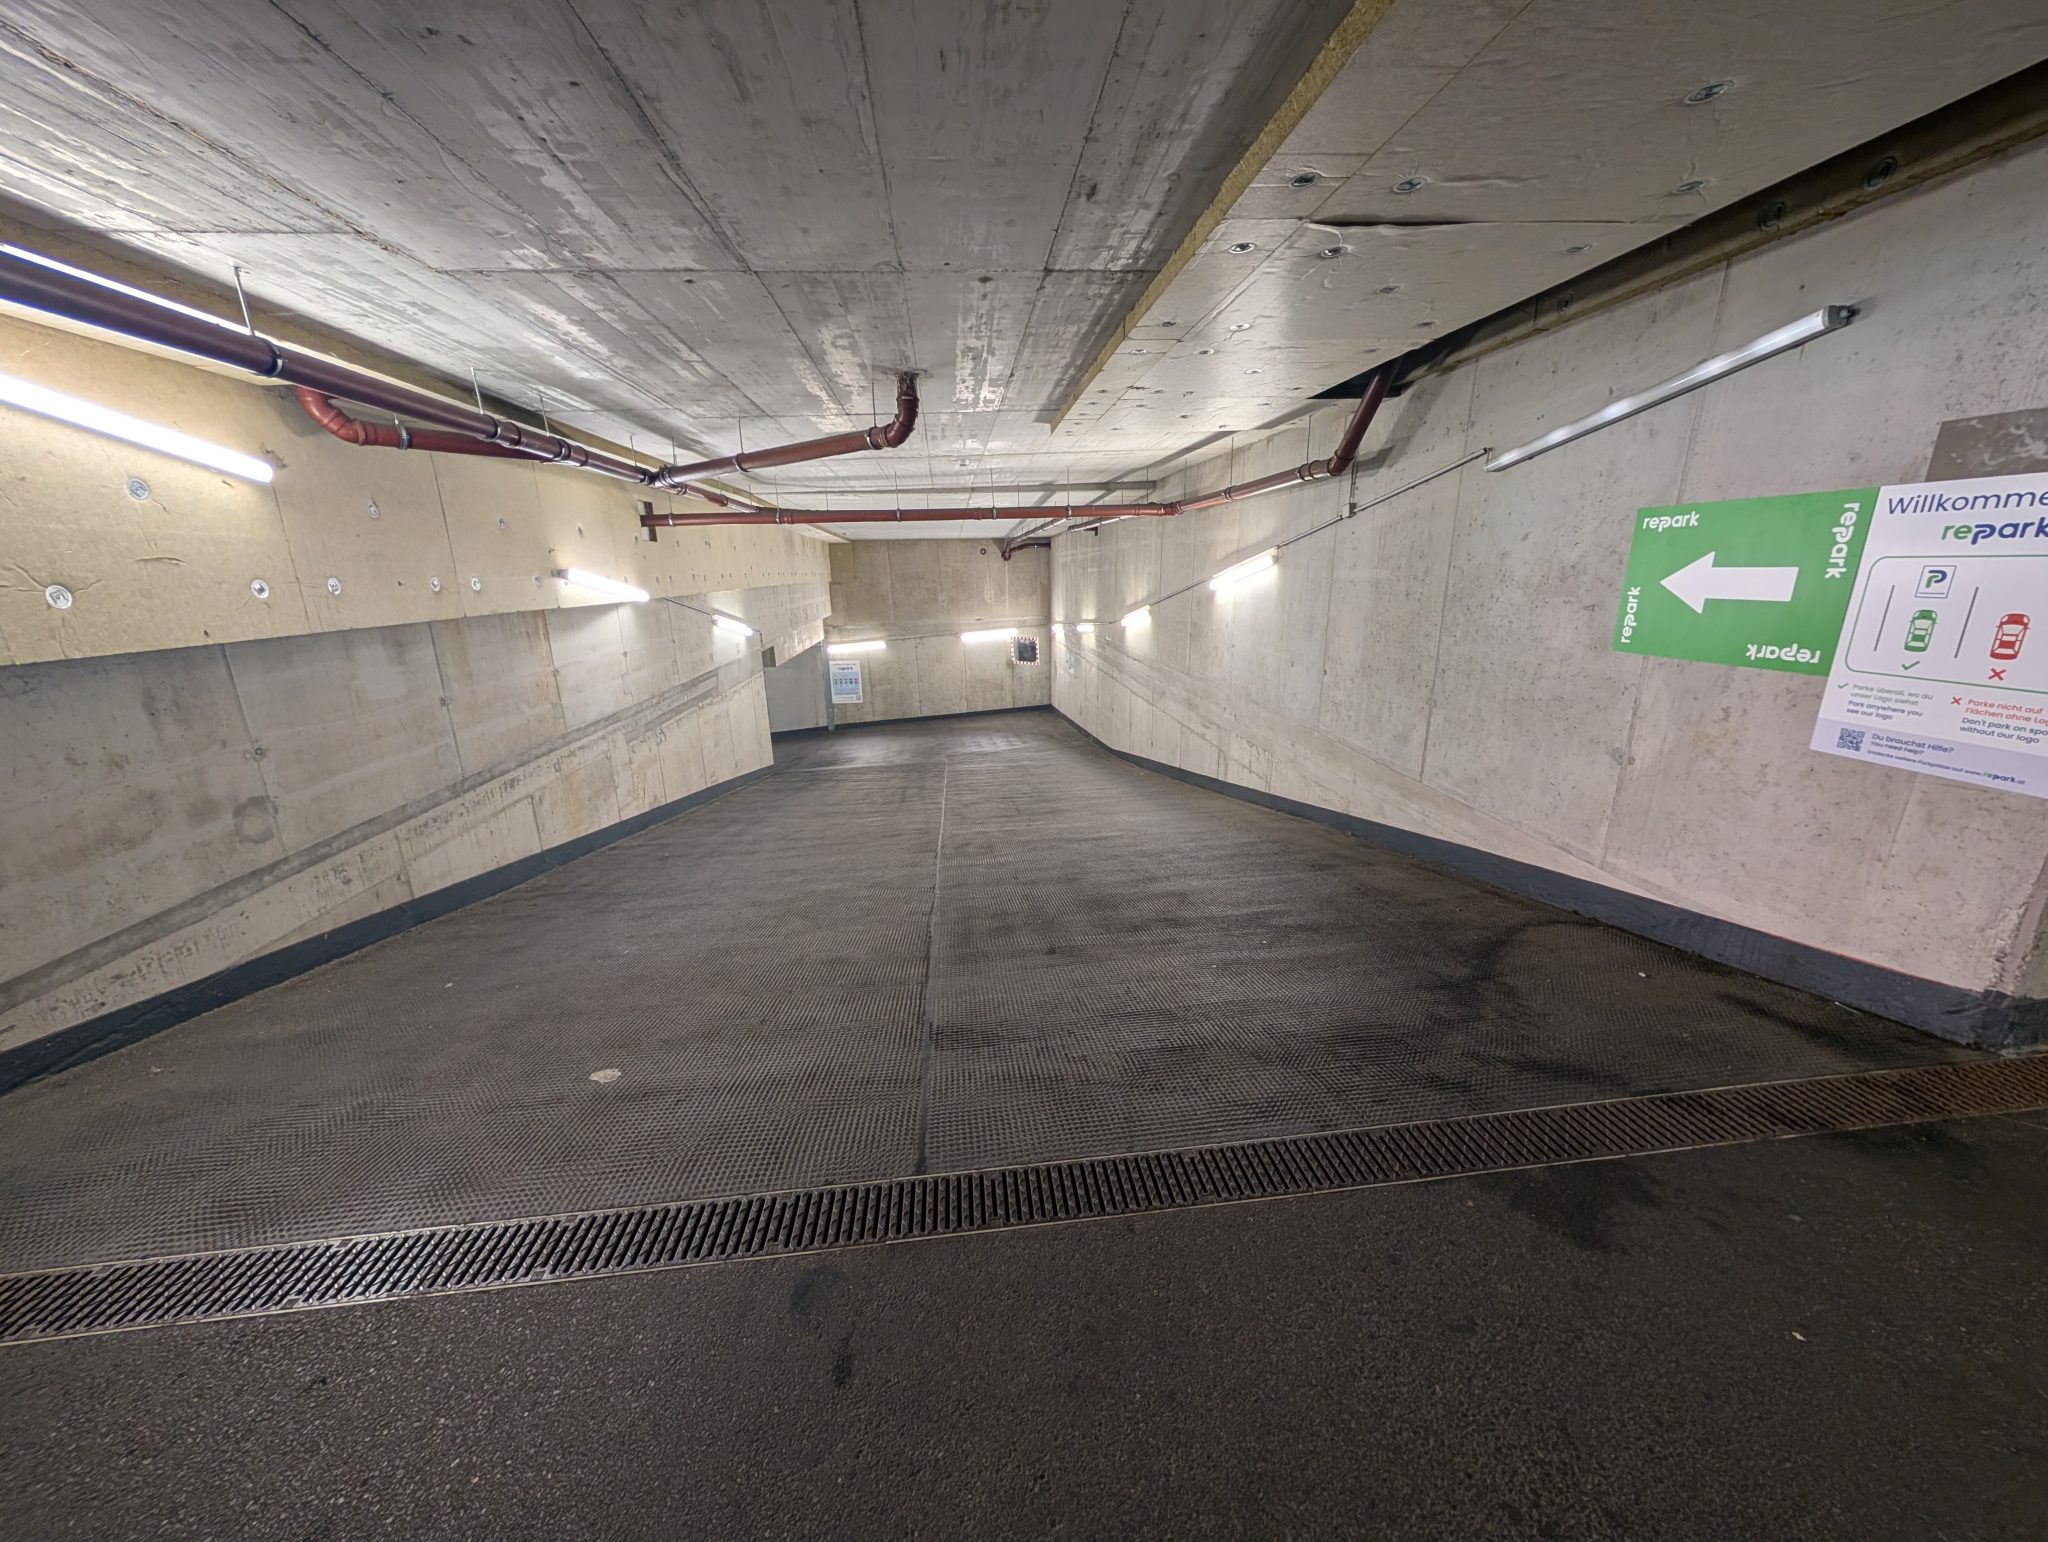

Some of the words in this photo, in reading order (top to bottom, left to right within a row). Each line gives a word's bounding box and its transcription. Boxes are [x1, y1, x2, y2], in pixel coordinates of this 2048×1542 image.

[1642, 511, 1700, 532] repark
[1941, 516, 2048, 545] repark
[1824, 502, 1861, 579] repark
[1620, 586, 1641, 643] repark
[1745, 643, 1822, 664] repark
[1848, 700, 1864, 708] Park
[1866, 703, 1906, 714] anywhere
[1907, 709, 1924, 717] you
[1965, 707, 2003, 718] Flächen
[2005, 713, 2032, 722] ohne
[1967, 698, 1995, 708] Parke
[1997, 702, 2023, 712] nicht
[2024, 706, 2044, 714] auf
[1875, 712, 1893, 721] logo
[1961, 717, 1987, 727] Don't
[1987, 720, 2011, 730] park
[2013, 725, 2027, 733] on
[1871, 733, 1884, 741] Du
[1885, 735, 1926, 749] brauchst
[1927, 743, 1955, 754] Hilfe?
[1960, 726, 1996, 737] without
[1997, 731, 2014, 740] our
[2016, 734, 2040, 745] logo
[1884, 743, 1903, 752] need
[1903, 747, 1925, 756] help?
